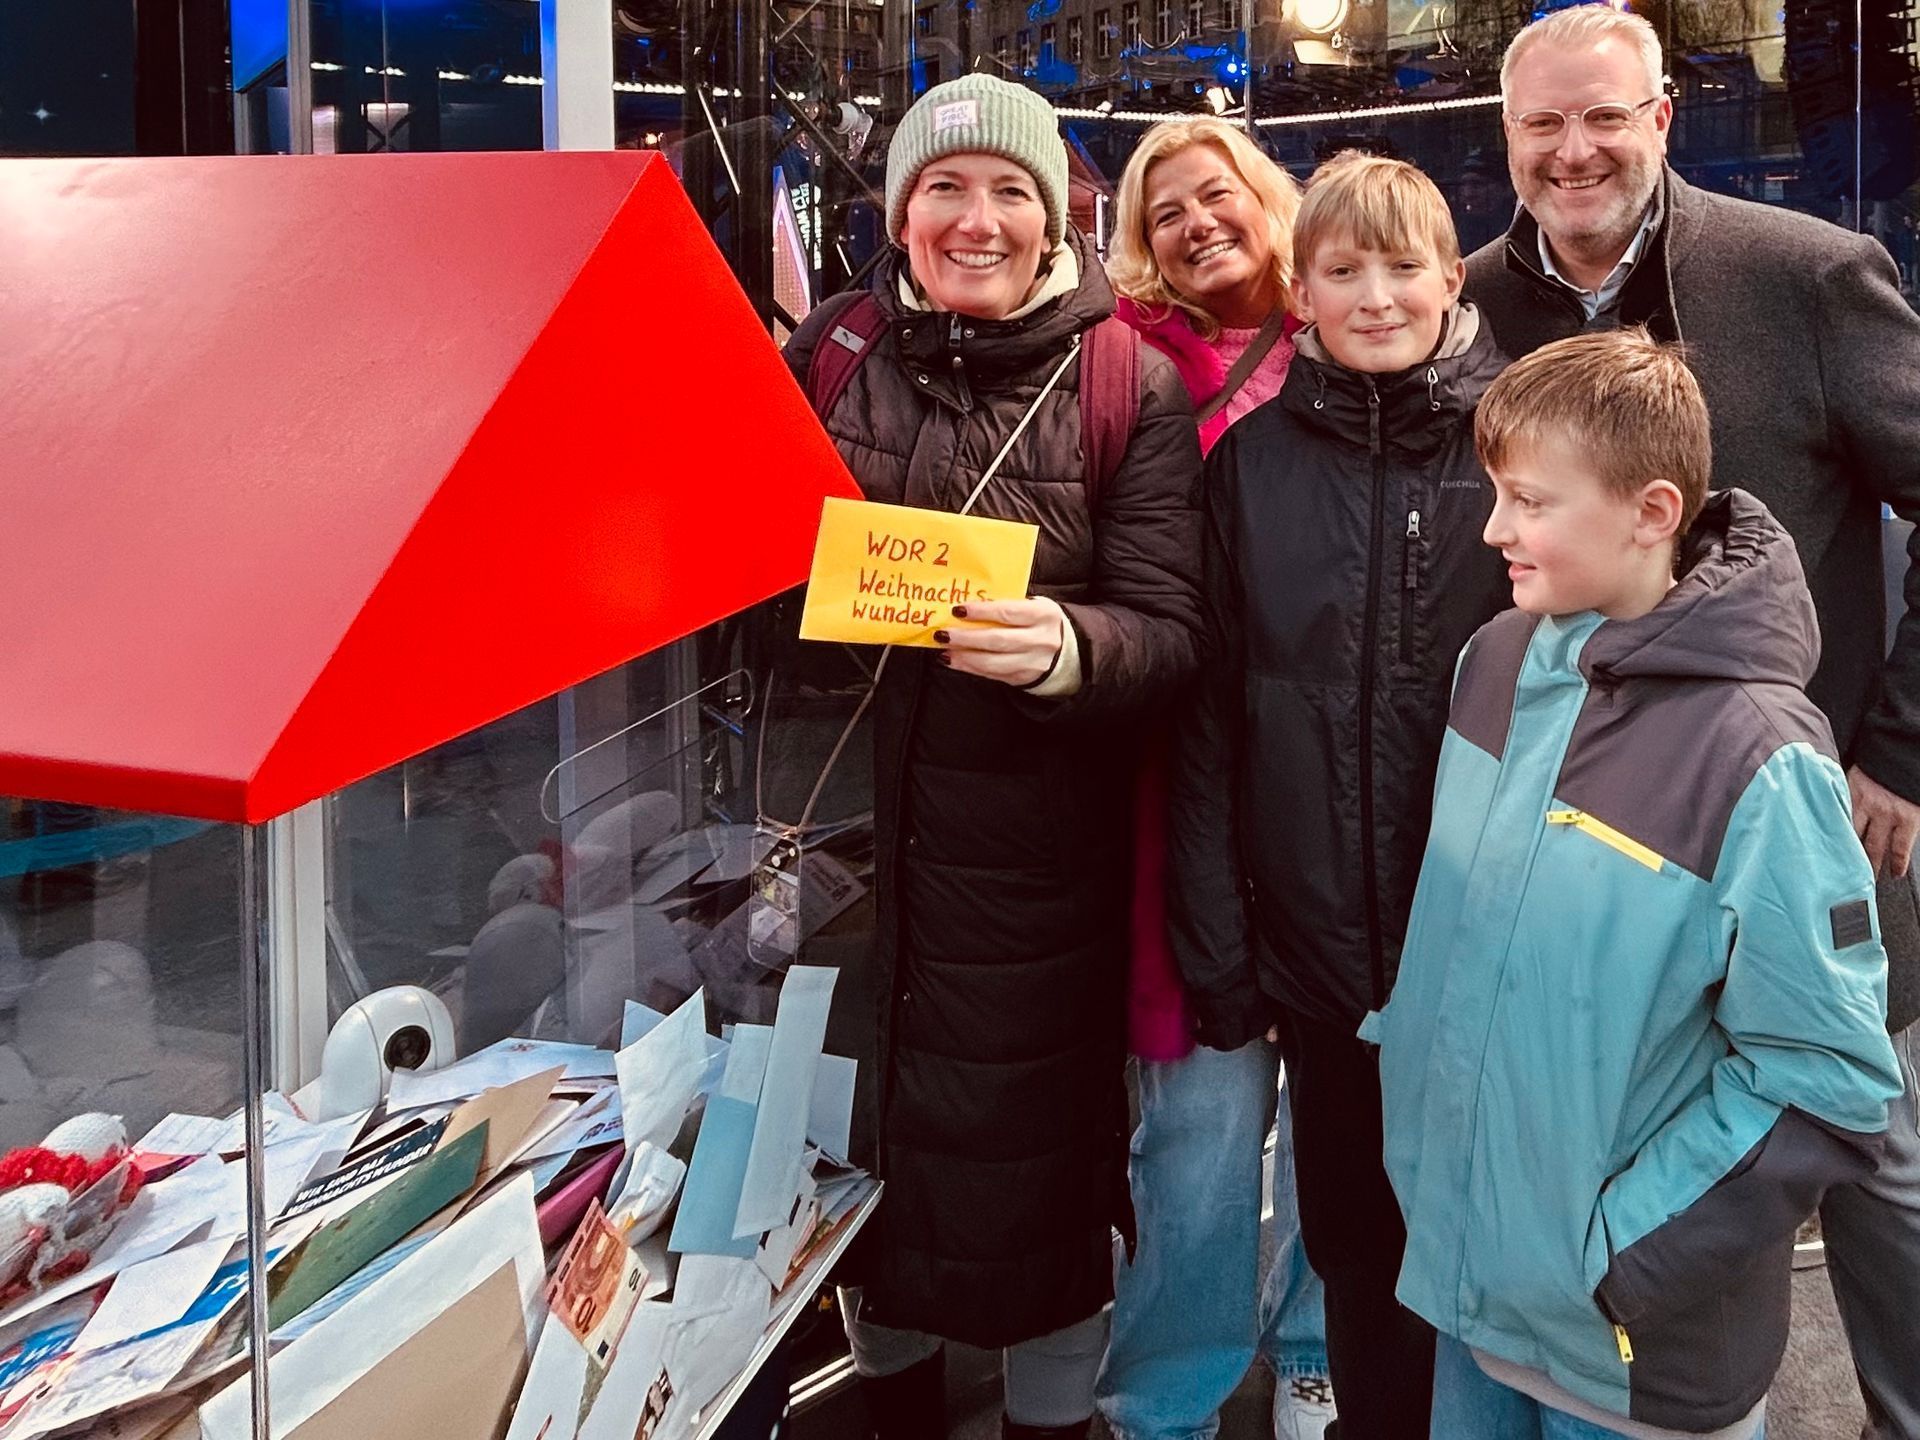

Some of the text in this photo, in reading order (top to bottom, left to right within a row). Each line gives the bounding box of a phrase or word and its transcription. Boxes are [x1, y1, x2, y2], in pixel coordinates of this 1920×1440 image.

[867, 530, 950, 567] WDR 2
[295, 1153, 389, 1203] WIR SIND DAS
[574, 1296, 598, 1335] 10
